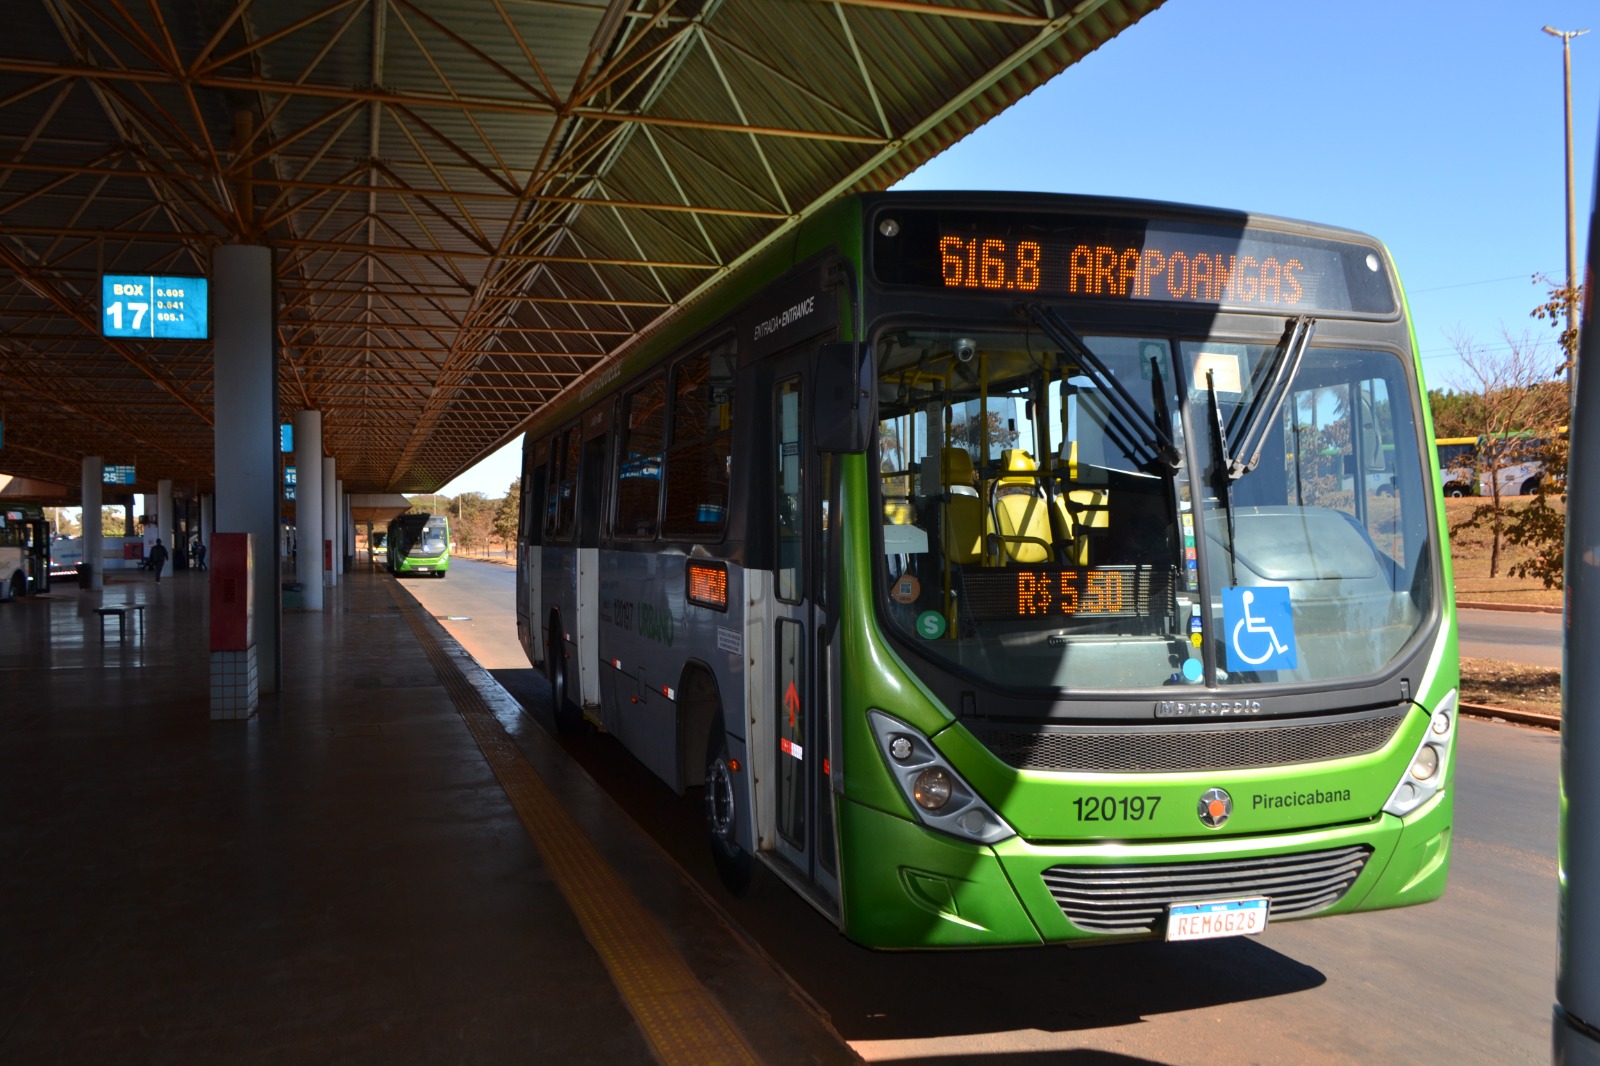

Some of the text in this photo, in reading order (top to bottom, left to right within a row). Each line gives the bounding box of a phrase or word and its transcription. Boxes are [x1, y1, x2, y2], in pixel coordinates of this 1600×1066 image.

[940, 236, 1304, 305] 616.8 ARAPOANGAS
[113, 283, 144, 296] BOX
[157, 288, 185, 297] 0.605
[106, 301, 149, 330] 17
[157, 312, 184, 321] 605.1
[753, 295, 815, 341] ENTRADA ENTRANCE
[103, 472, 116, 482] 25
[1018, 571, 1052, 614] R$
[637, 601, 674, 648] URBANO
[923, 615, 939, 635] S
[1159, 699, 1261, 716] Marcopolo
[1072, 796, 1162, 822] 120197
[1252, 789, 1351, 810] Piracicabana
[1177, 911, 1256, 936] REM6G28
